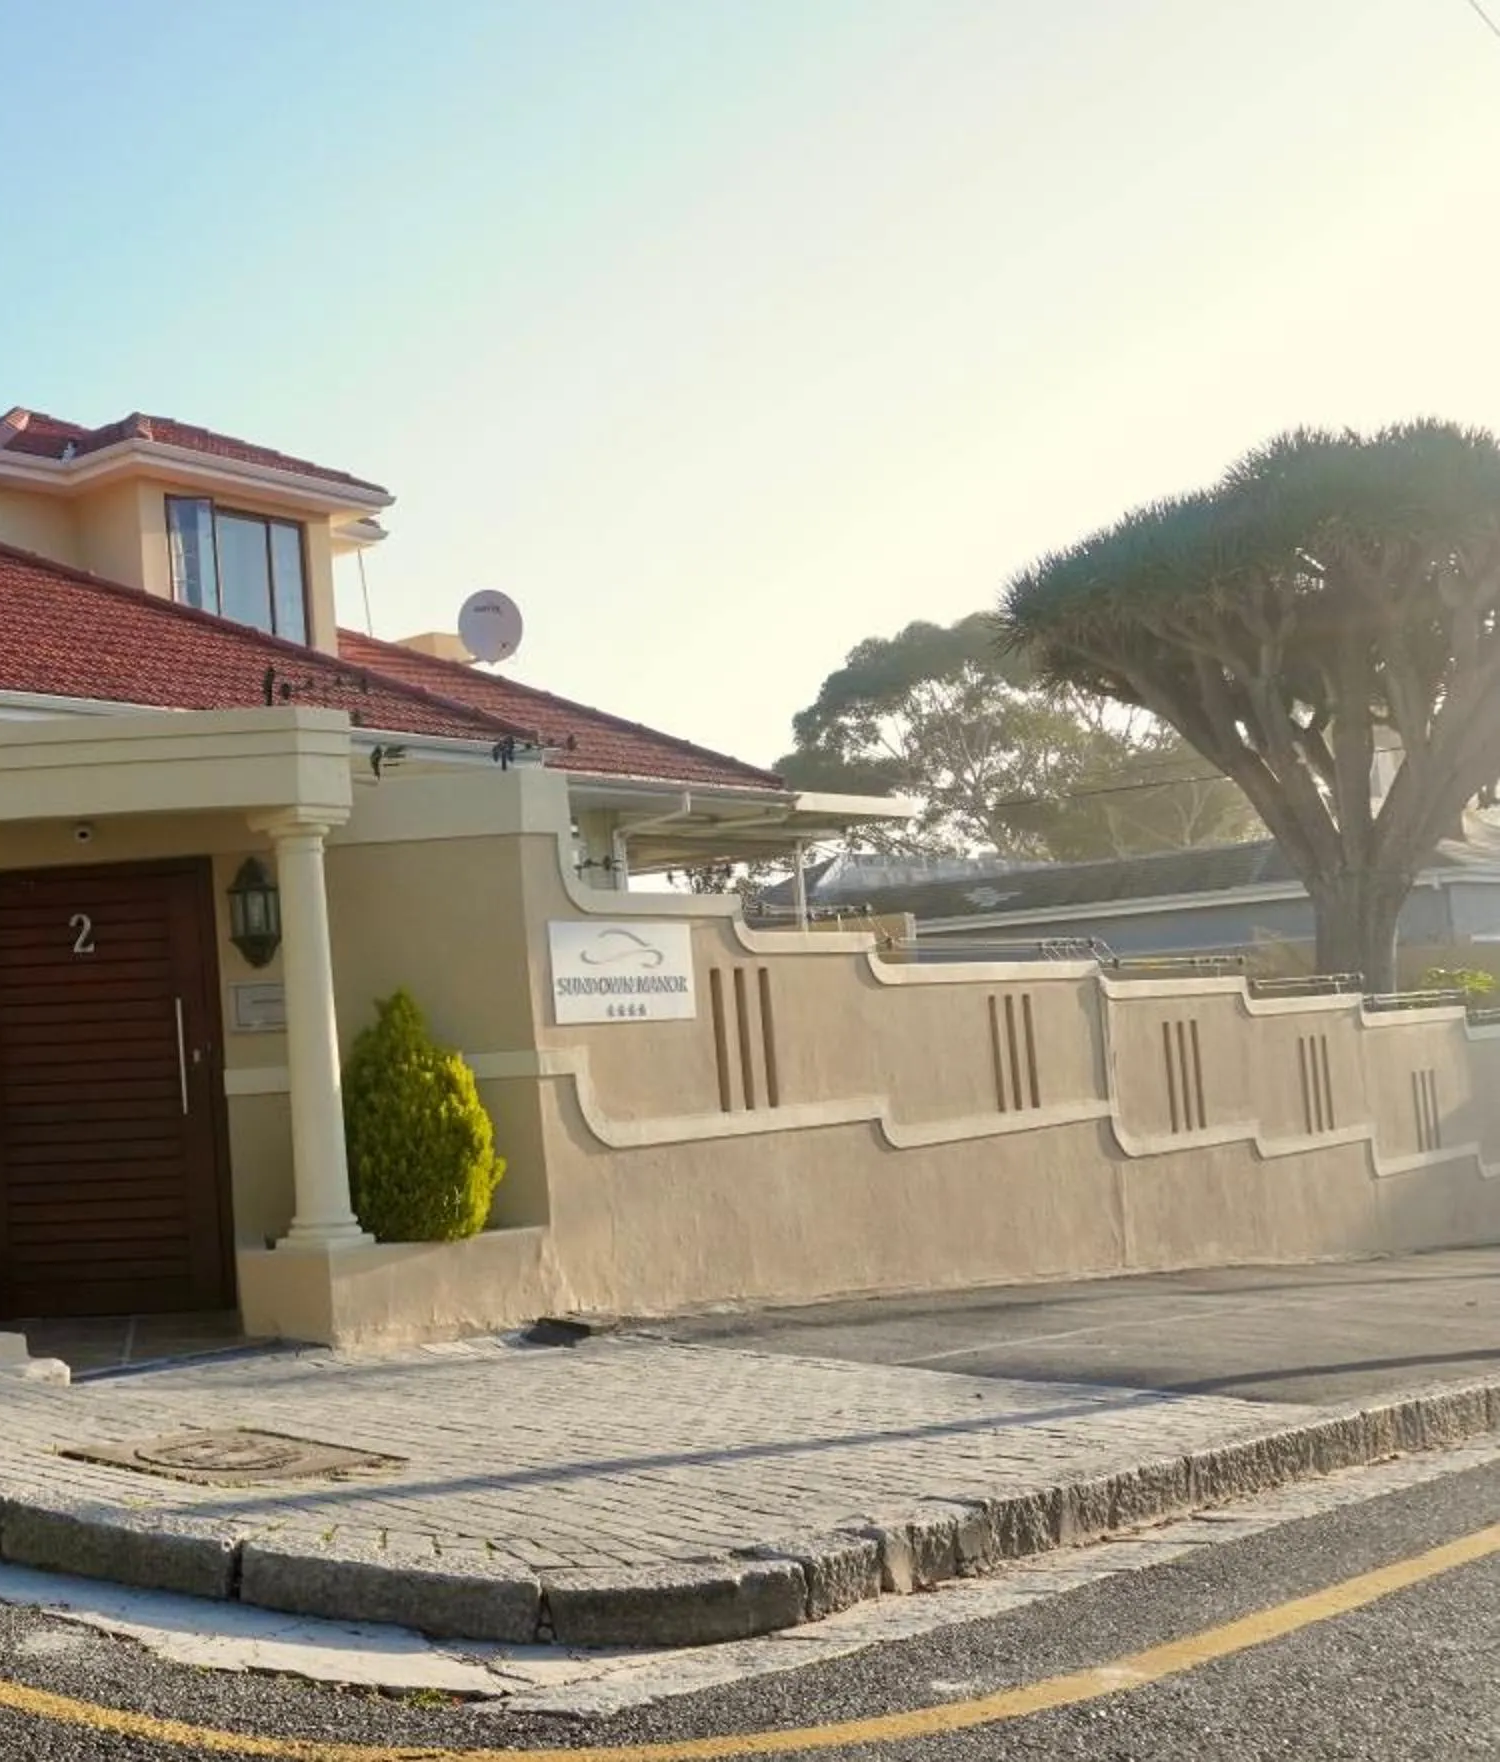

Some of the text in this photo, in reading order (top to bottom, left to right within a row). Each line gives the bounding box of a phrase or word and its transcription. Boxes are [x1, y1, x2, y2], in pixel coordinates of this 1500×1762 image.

[69, 913, 95, 953] 2
[557, 976, 688, 995] SUNDOWN MANOR
